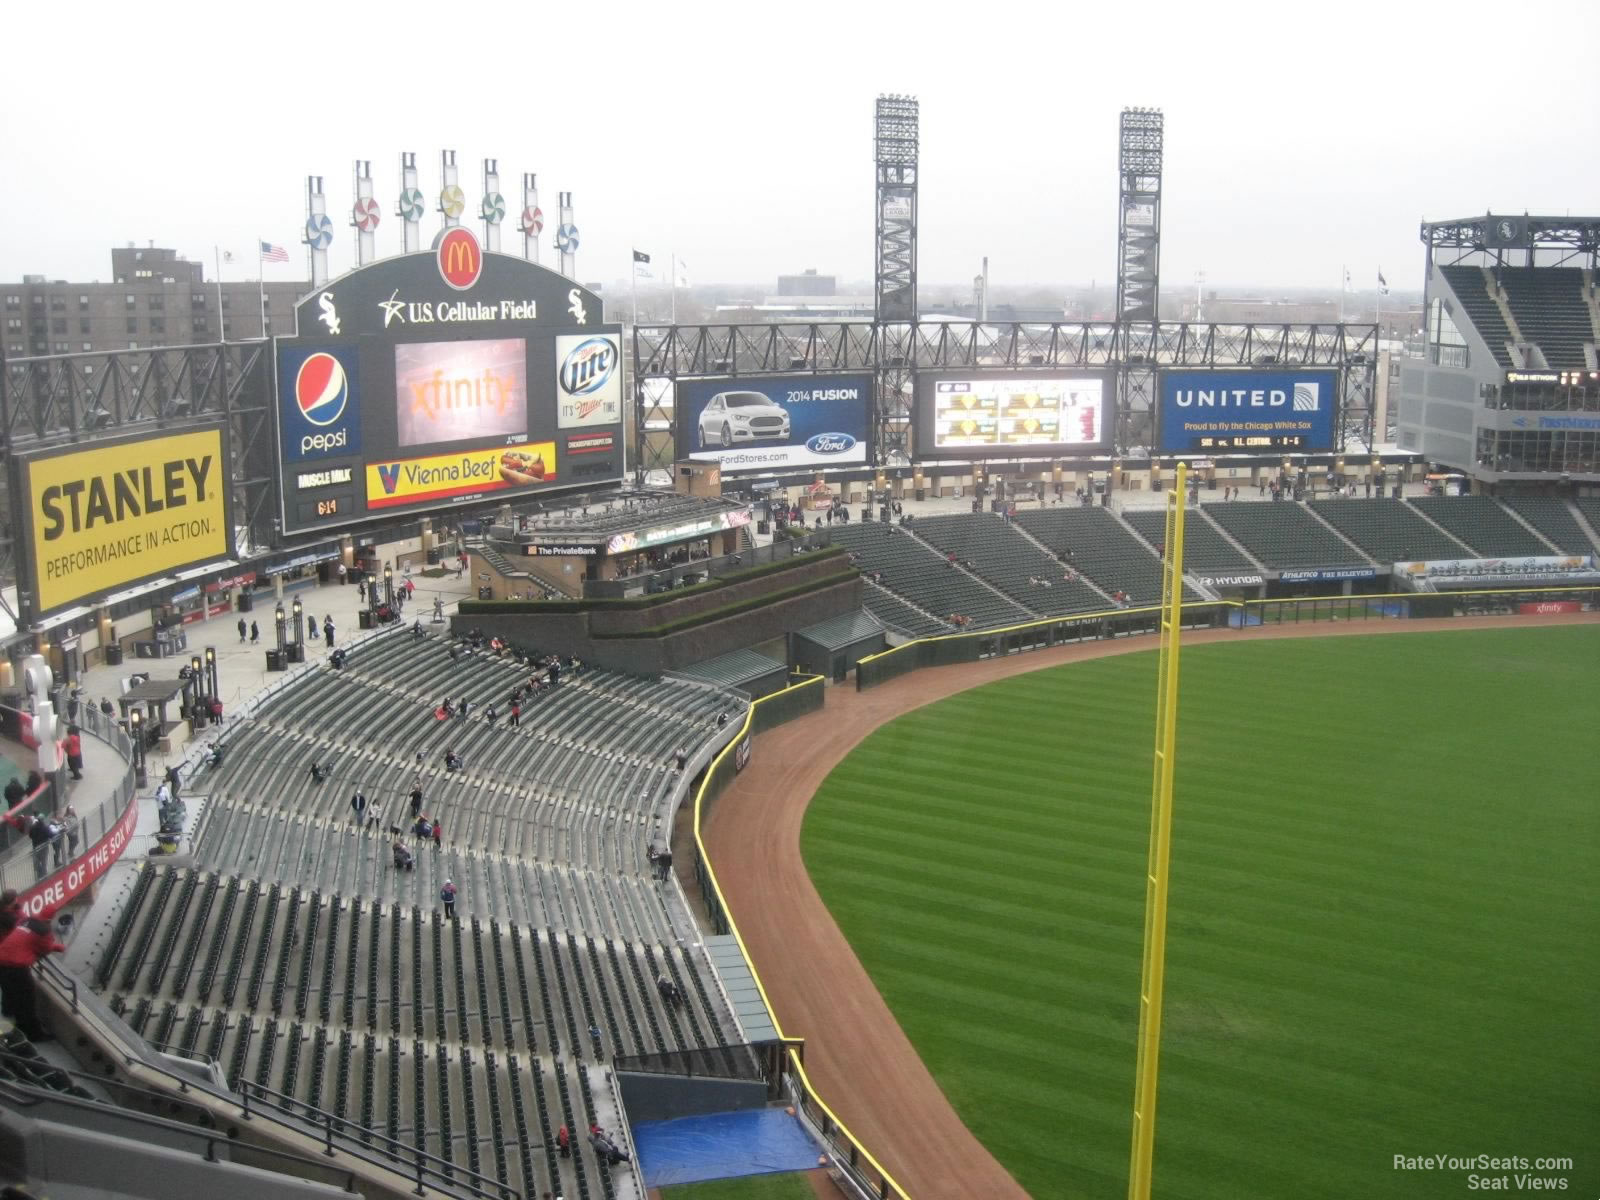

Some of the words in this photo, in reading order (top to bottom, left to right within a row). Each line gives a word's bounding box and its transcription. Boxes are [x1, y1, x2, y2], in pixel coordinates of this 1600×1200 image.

[410, 303, 434, 323] U.S.
[437, 302, 498, 322] Cellular
[500, 300, 536, 320] Field
[570, 348, 610, 394] Lite
[409, 369, 514, 420] xfinity
[787, 390, 810, 403] 2014
[812, 389, 858, 401] FUSION
[1176, 390, 1286, 407] UNITED
[562, 404, 574, 416] IT'S
[603, 401, 616, 413] TIME
[1184, 423, 1207, 431] Proud
[1218, 422, 1229, 431] fly
[1231, 422, 1243, 430] the
[1244, 422, 1273, 431] Chicago
[1275, 421, 1297, 430] White
[1298, 421, 1312, 430] Sox
[301, 428, 347, 455] pepsi
[815, 435, 846, 451] Ford
[298, 472, 331, 489] MUSCLE
[331, 468, 352, 484] MILK
[405, 462, 460, 486] Vienna
[462, 455, 495, 481] Beef
[41, 455, 213, 542] STANLEY
[47, 534, 143, 581] PERFORMANCE
[146, 531, 159, 551] IN
[162, 518, 210, 545] ACTION
[538, 547, 552, 555] The
[553, 547, 597, 555] PrivateBank
[1215, 575, 1263, 585] HYUNDAI
[1282, 570, 1319, 579] ATHLETICO
[1536, 603, 1562, 613] xfinity
[68, 865, 86, 890] OF
[88, 845, 109, 873] THE
[110, 827, 125, 855] SOX
